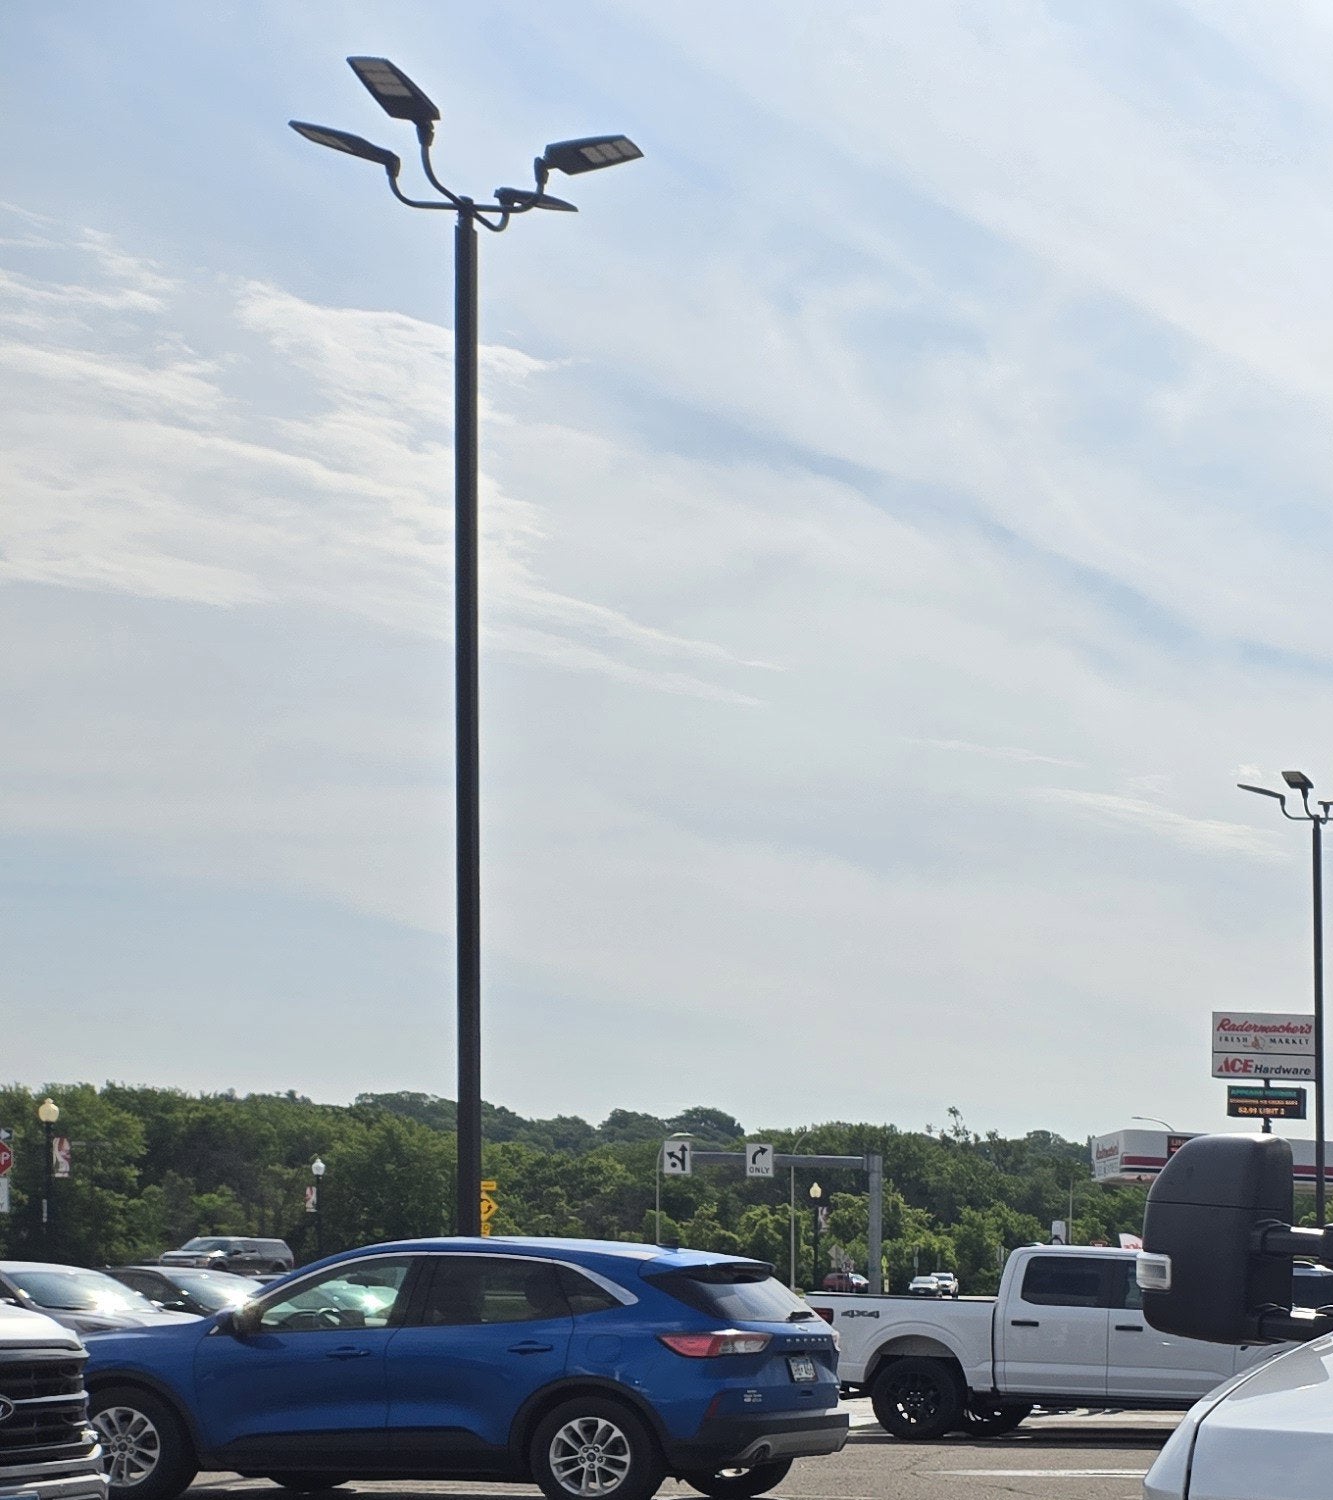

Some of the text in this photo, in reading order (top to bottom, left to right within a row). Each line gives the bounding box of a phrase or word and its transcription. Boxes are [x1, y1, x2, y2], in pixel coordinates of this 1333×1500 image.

[1217, 1018, 1313, 1034] Radermacher's
[1219, 1035, 1310, 1045] FRESH MARKET
[1217, 1057, 1311, 1076] ACE Hardware
[749, 1166, 770, 1174] ONLY
